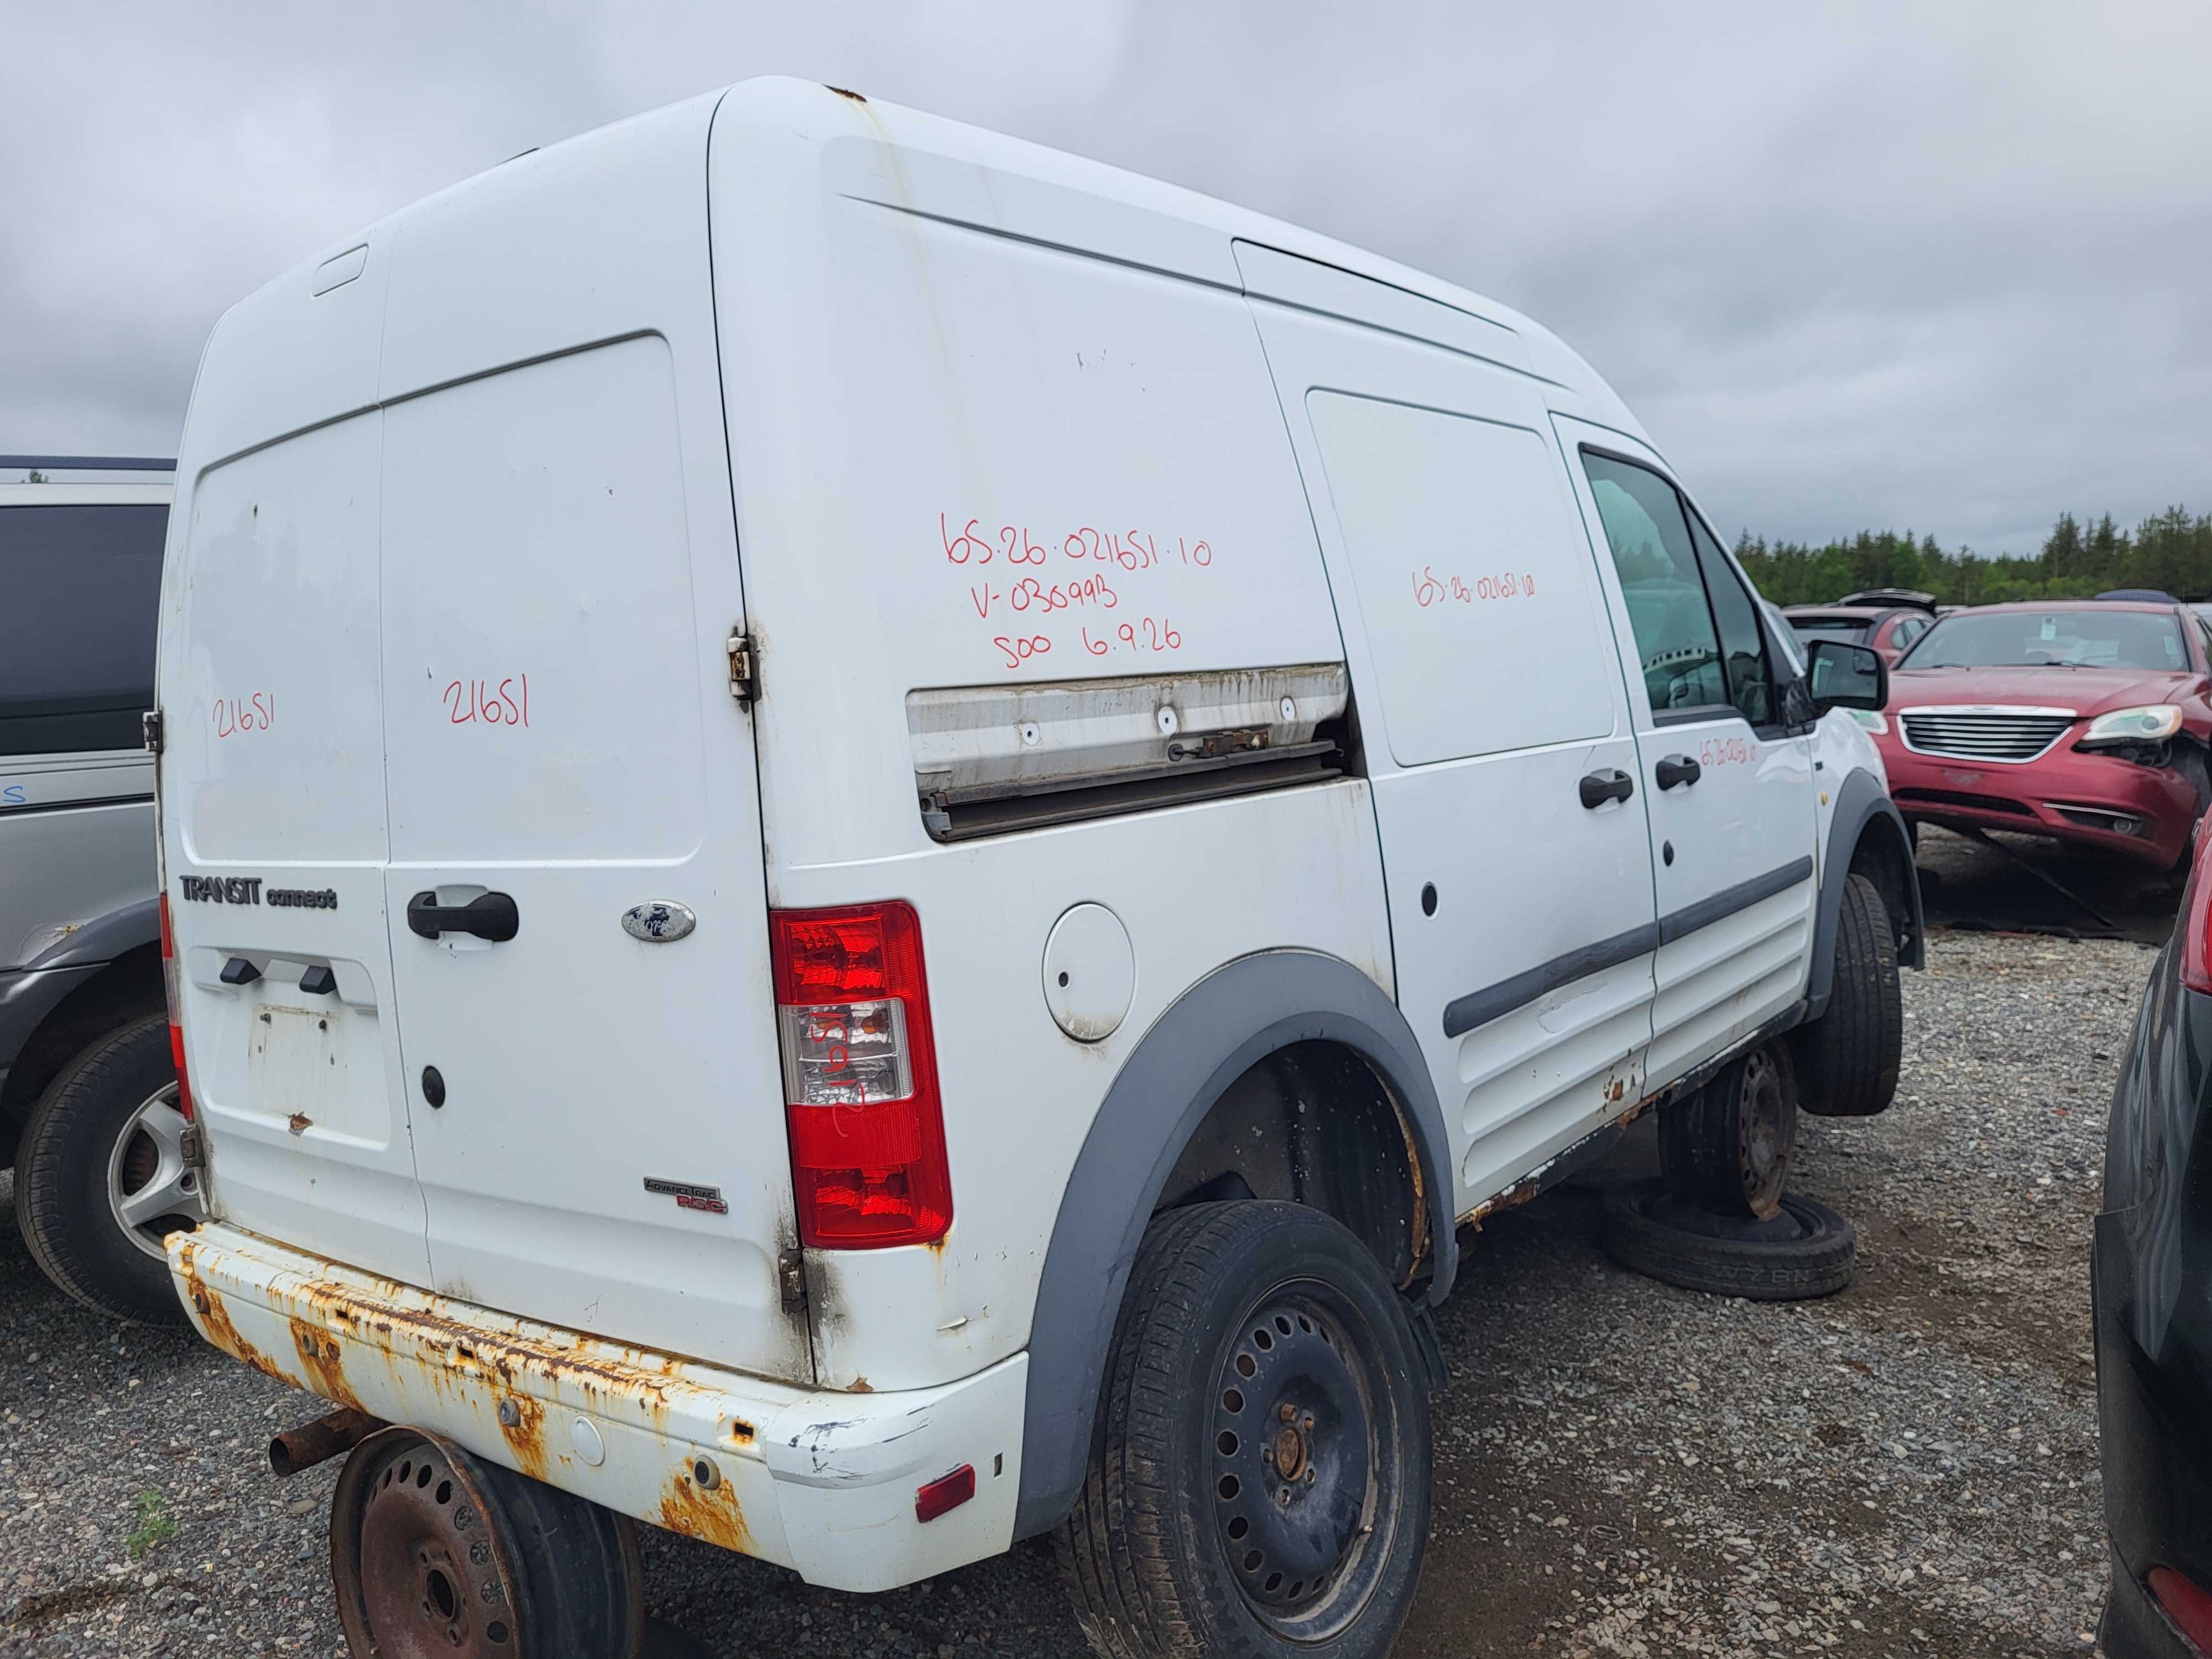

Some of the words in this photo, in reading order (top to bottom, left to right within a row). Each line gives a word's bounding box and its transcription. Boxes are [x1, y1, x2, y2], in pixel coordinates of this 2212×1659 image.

[212, 692, 274, 738] 21651
[442, 673, 529, 727] 21651
[179, 875, 262, 905] TRANSIT
[266, 888, 338, 909] connect
[676, 1193, 729, 1215] RSC
